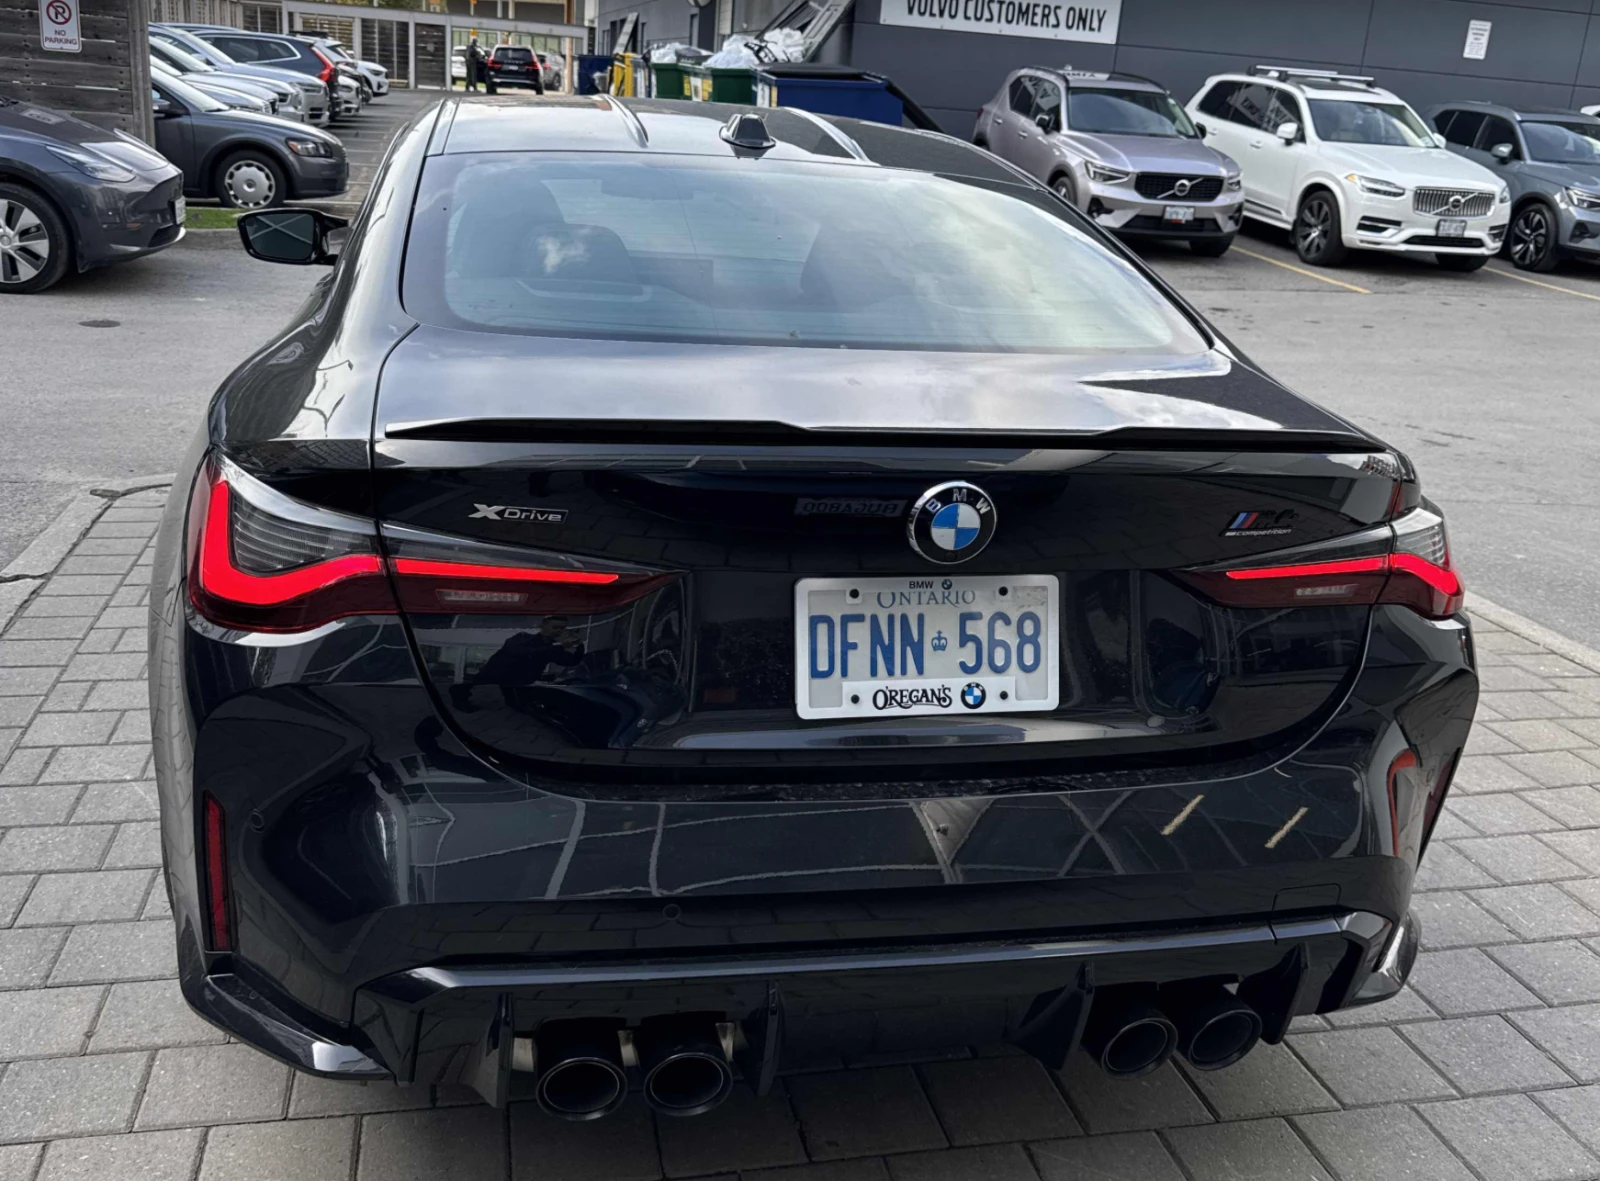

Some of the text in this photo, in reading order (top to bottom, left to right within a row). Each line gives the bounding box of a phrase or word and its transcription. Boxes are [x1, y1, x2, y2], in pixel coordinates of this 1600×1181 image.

[907, 0, 1107, 33] VOLVO CUSTOMERS ONLY
[44, 37, 77, 45] PARKING
[925, 488, 991, 515] BMW
[1235, 528, 1292, 537] competition
[909, 581, 934, 589] BMW
[877, 591, 976, 609] ONTARIO
[809, 611, 1042, 679] DFNN 568
[873, 684, 953, 710] O'REGAN'S
